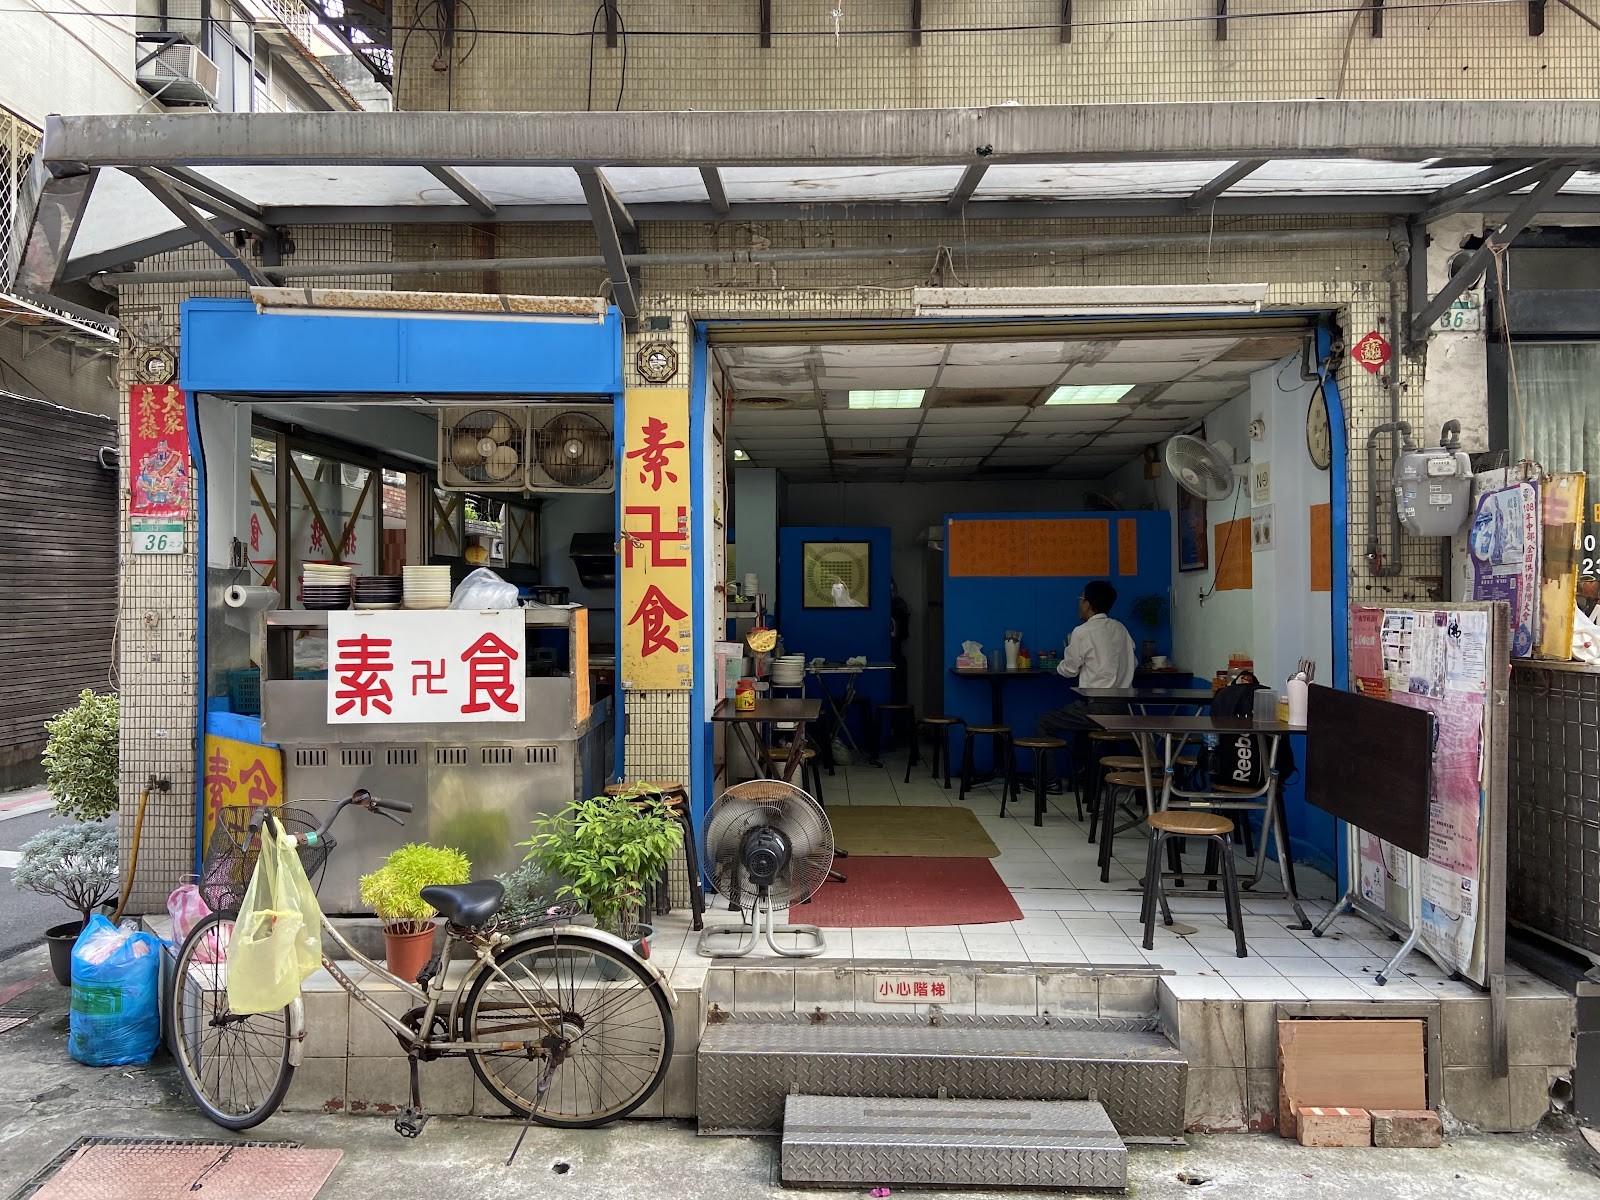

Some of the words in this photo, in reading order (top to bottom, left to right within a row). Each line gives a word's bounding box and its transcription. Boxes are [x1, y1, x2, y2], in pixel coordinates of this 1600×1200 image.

[1441, 311, 1464, 328] 36
[161, 385, 185, 435] 大家
[145, 534, 168, 551] 36
[879, 981, 946, 997] 小心階梯
